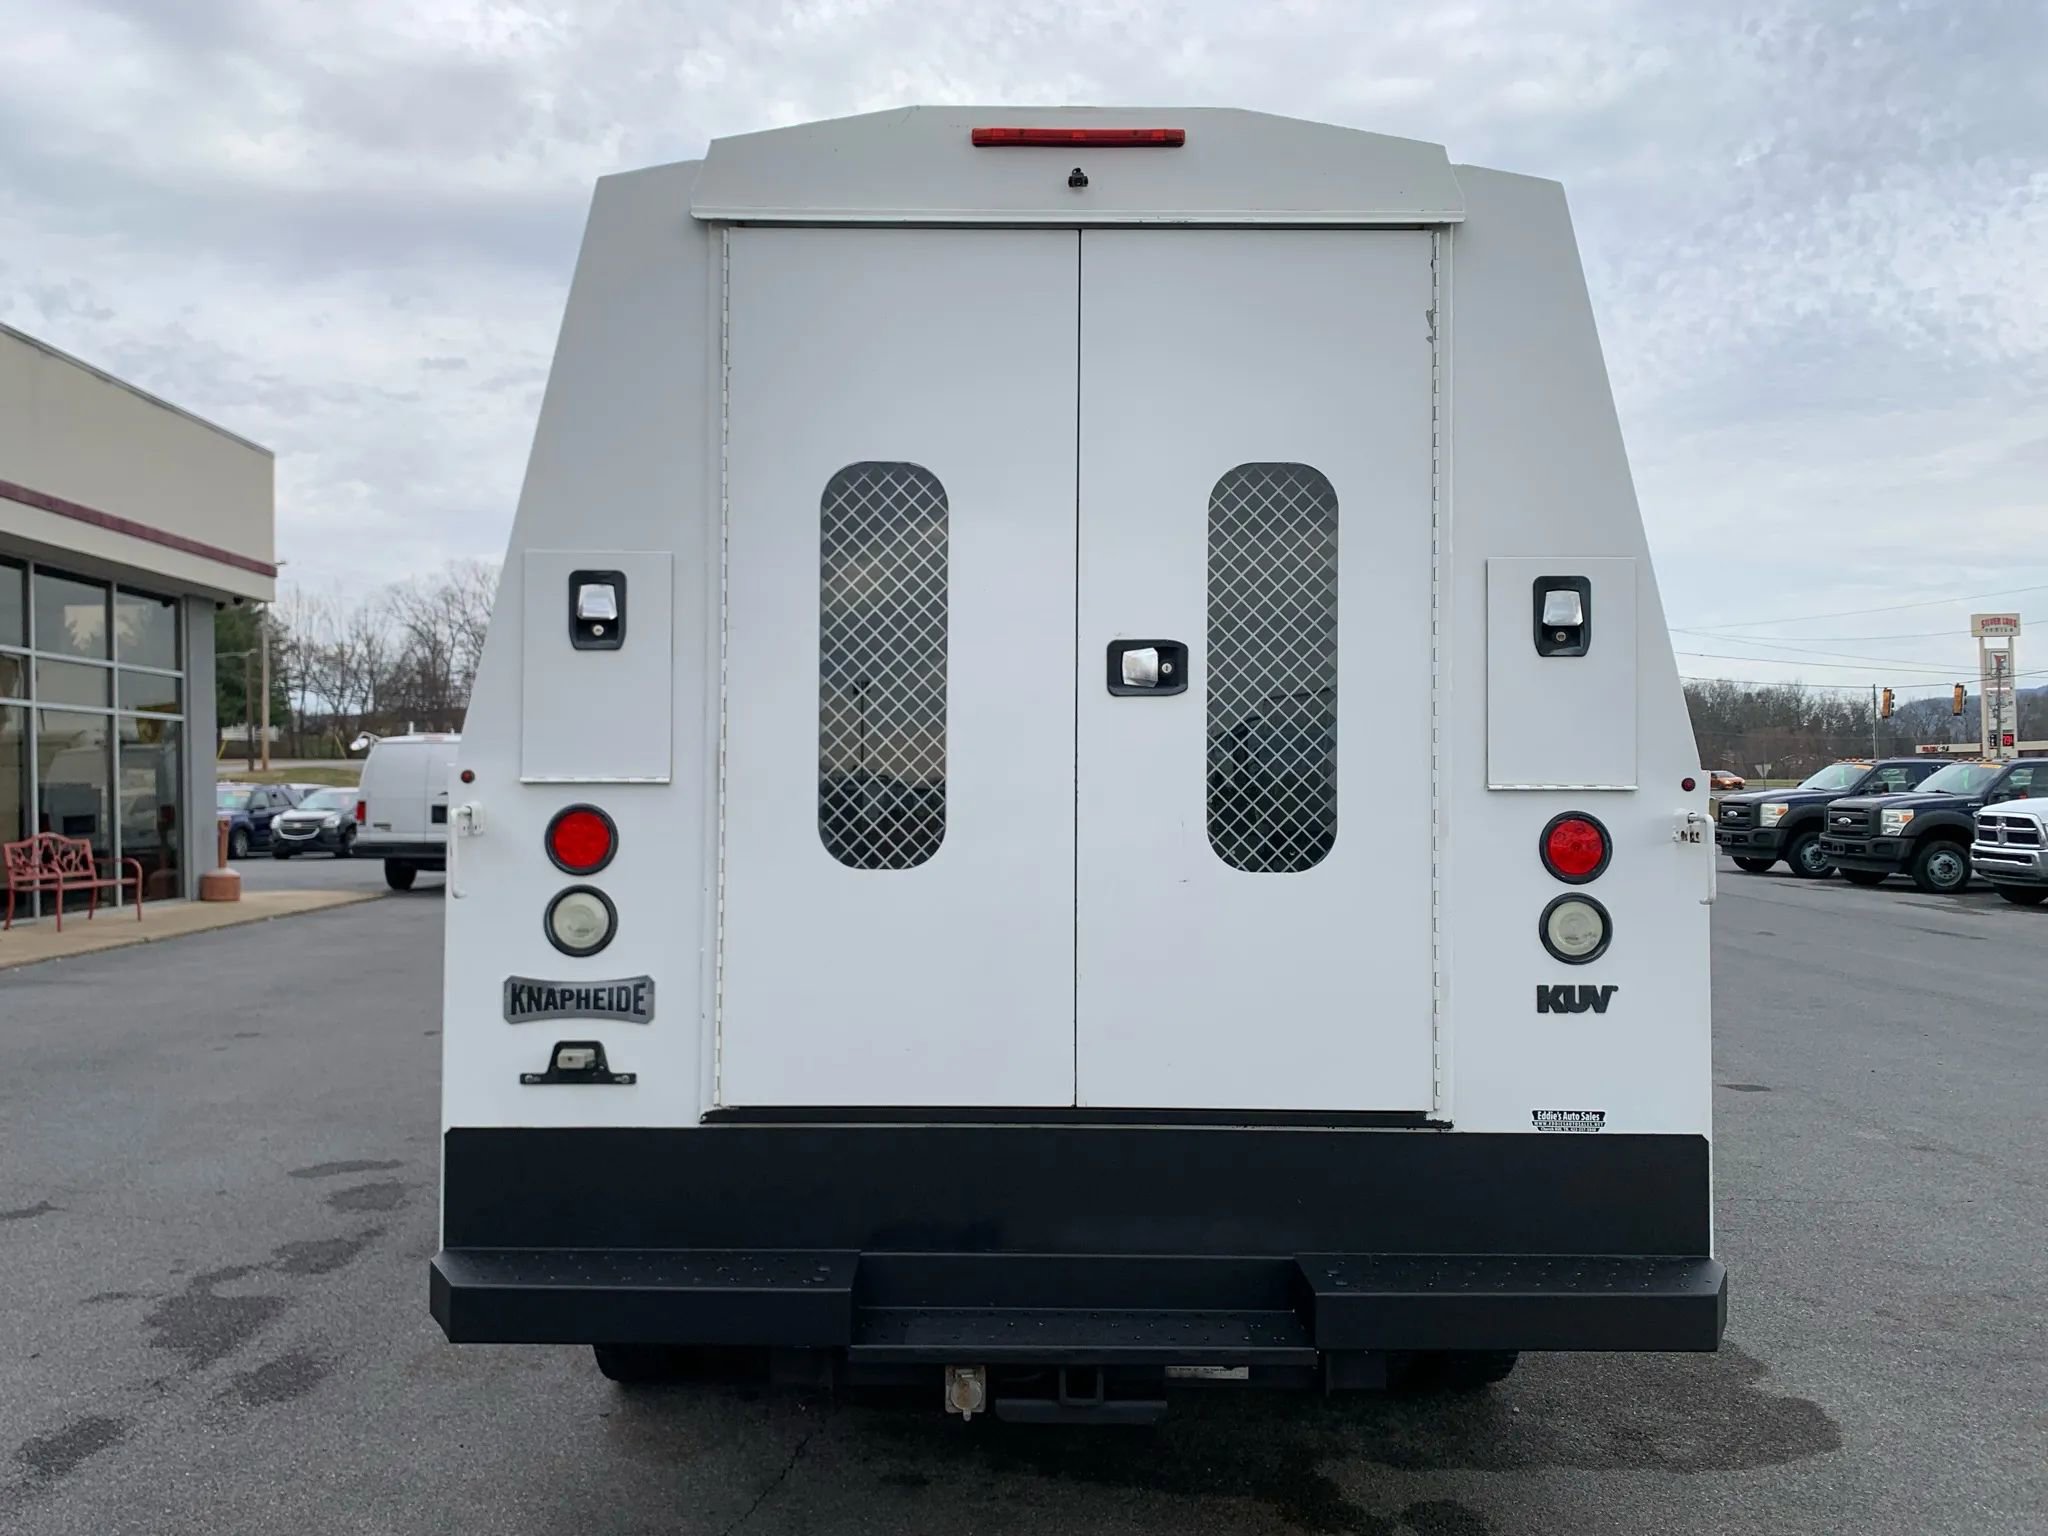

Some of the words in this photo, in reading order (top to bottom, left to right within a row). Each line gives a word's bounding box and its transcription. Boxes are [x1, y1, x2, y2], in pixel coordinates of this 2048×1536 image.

[510, 982, 647, 1016] KNAPHEIDE
[1537, 985, 1618, 1013] KUV
[1537, 1111, 1562, 1121] Eddie's
[1563, 1112, 1580, 1121] Auto
[1581, 1112, 1600, 1121] Sales
